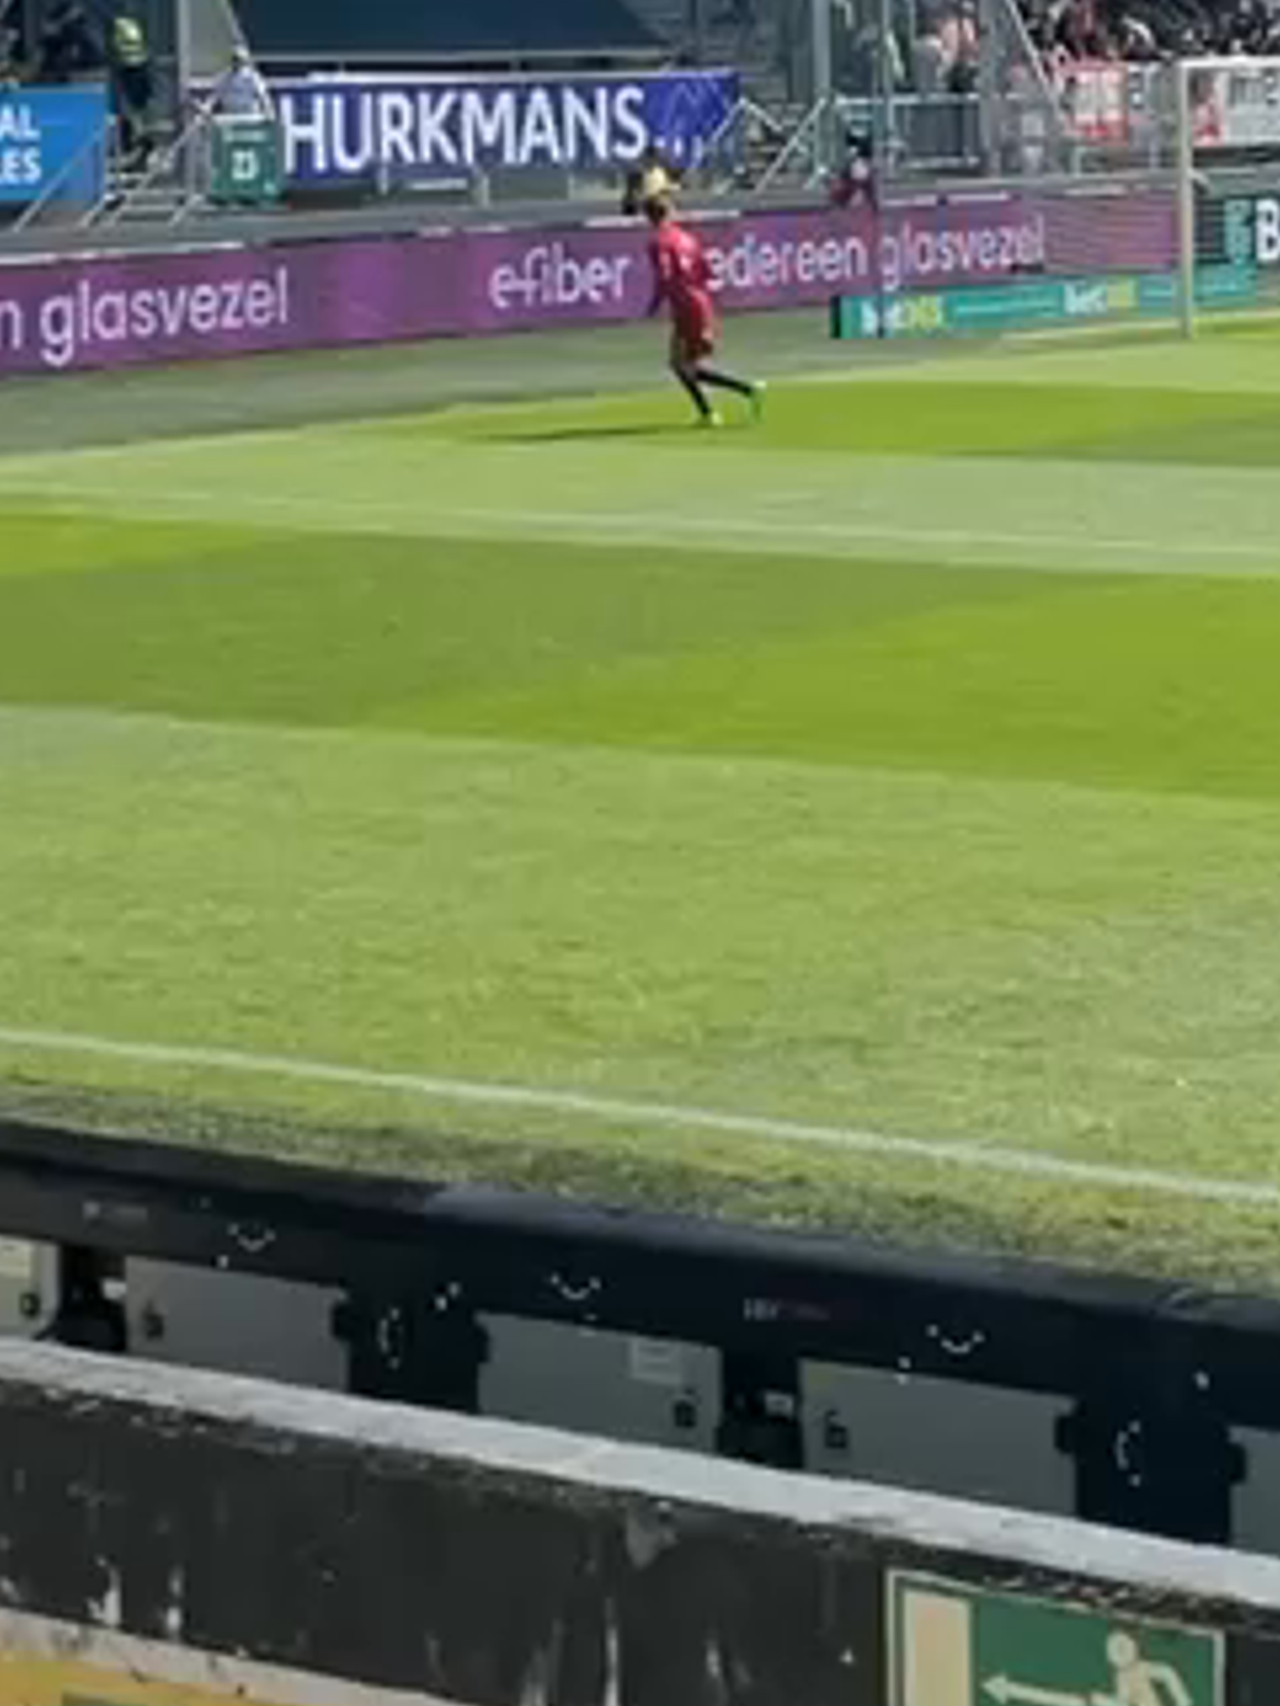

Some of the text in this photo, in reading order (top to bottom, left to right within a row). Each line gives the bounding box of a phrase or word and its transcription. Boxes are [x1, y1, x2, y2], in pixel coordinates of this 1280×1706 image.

[278, 86, 648, 174] HURKMANS
[704, 232, 869, 292] edereen
[880, 214, 1047, 292] glasvezel
[39, 268, 290, 367] glasvezel
